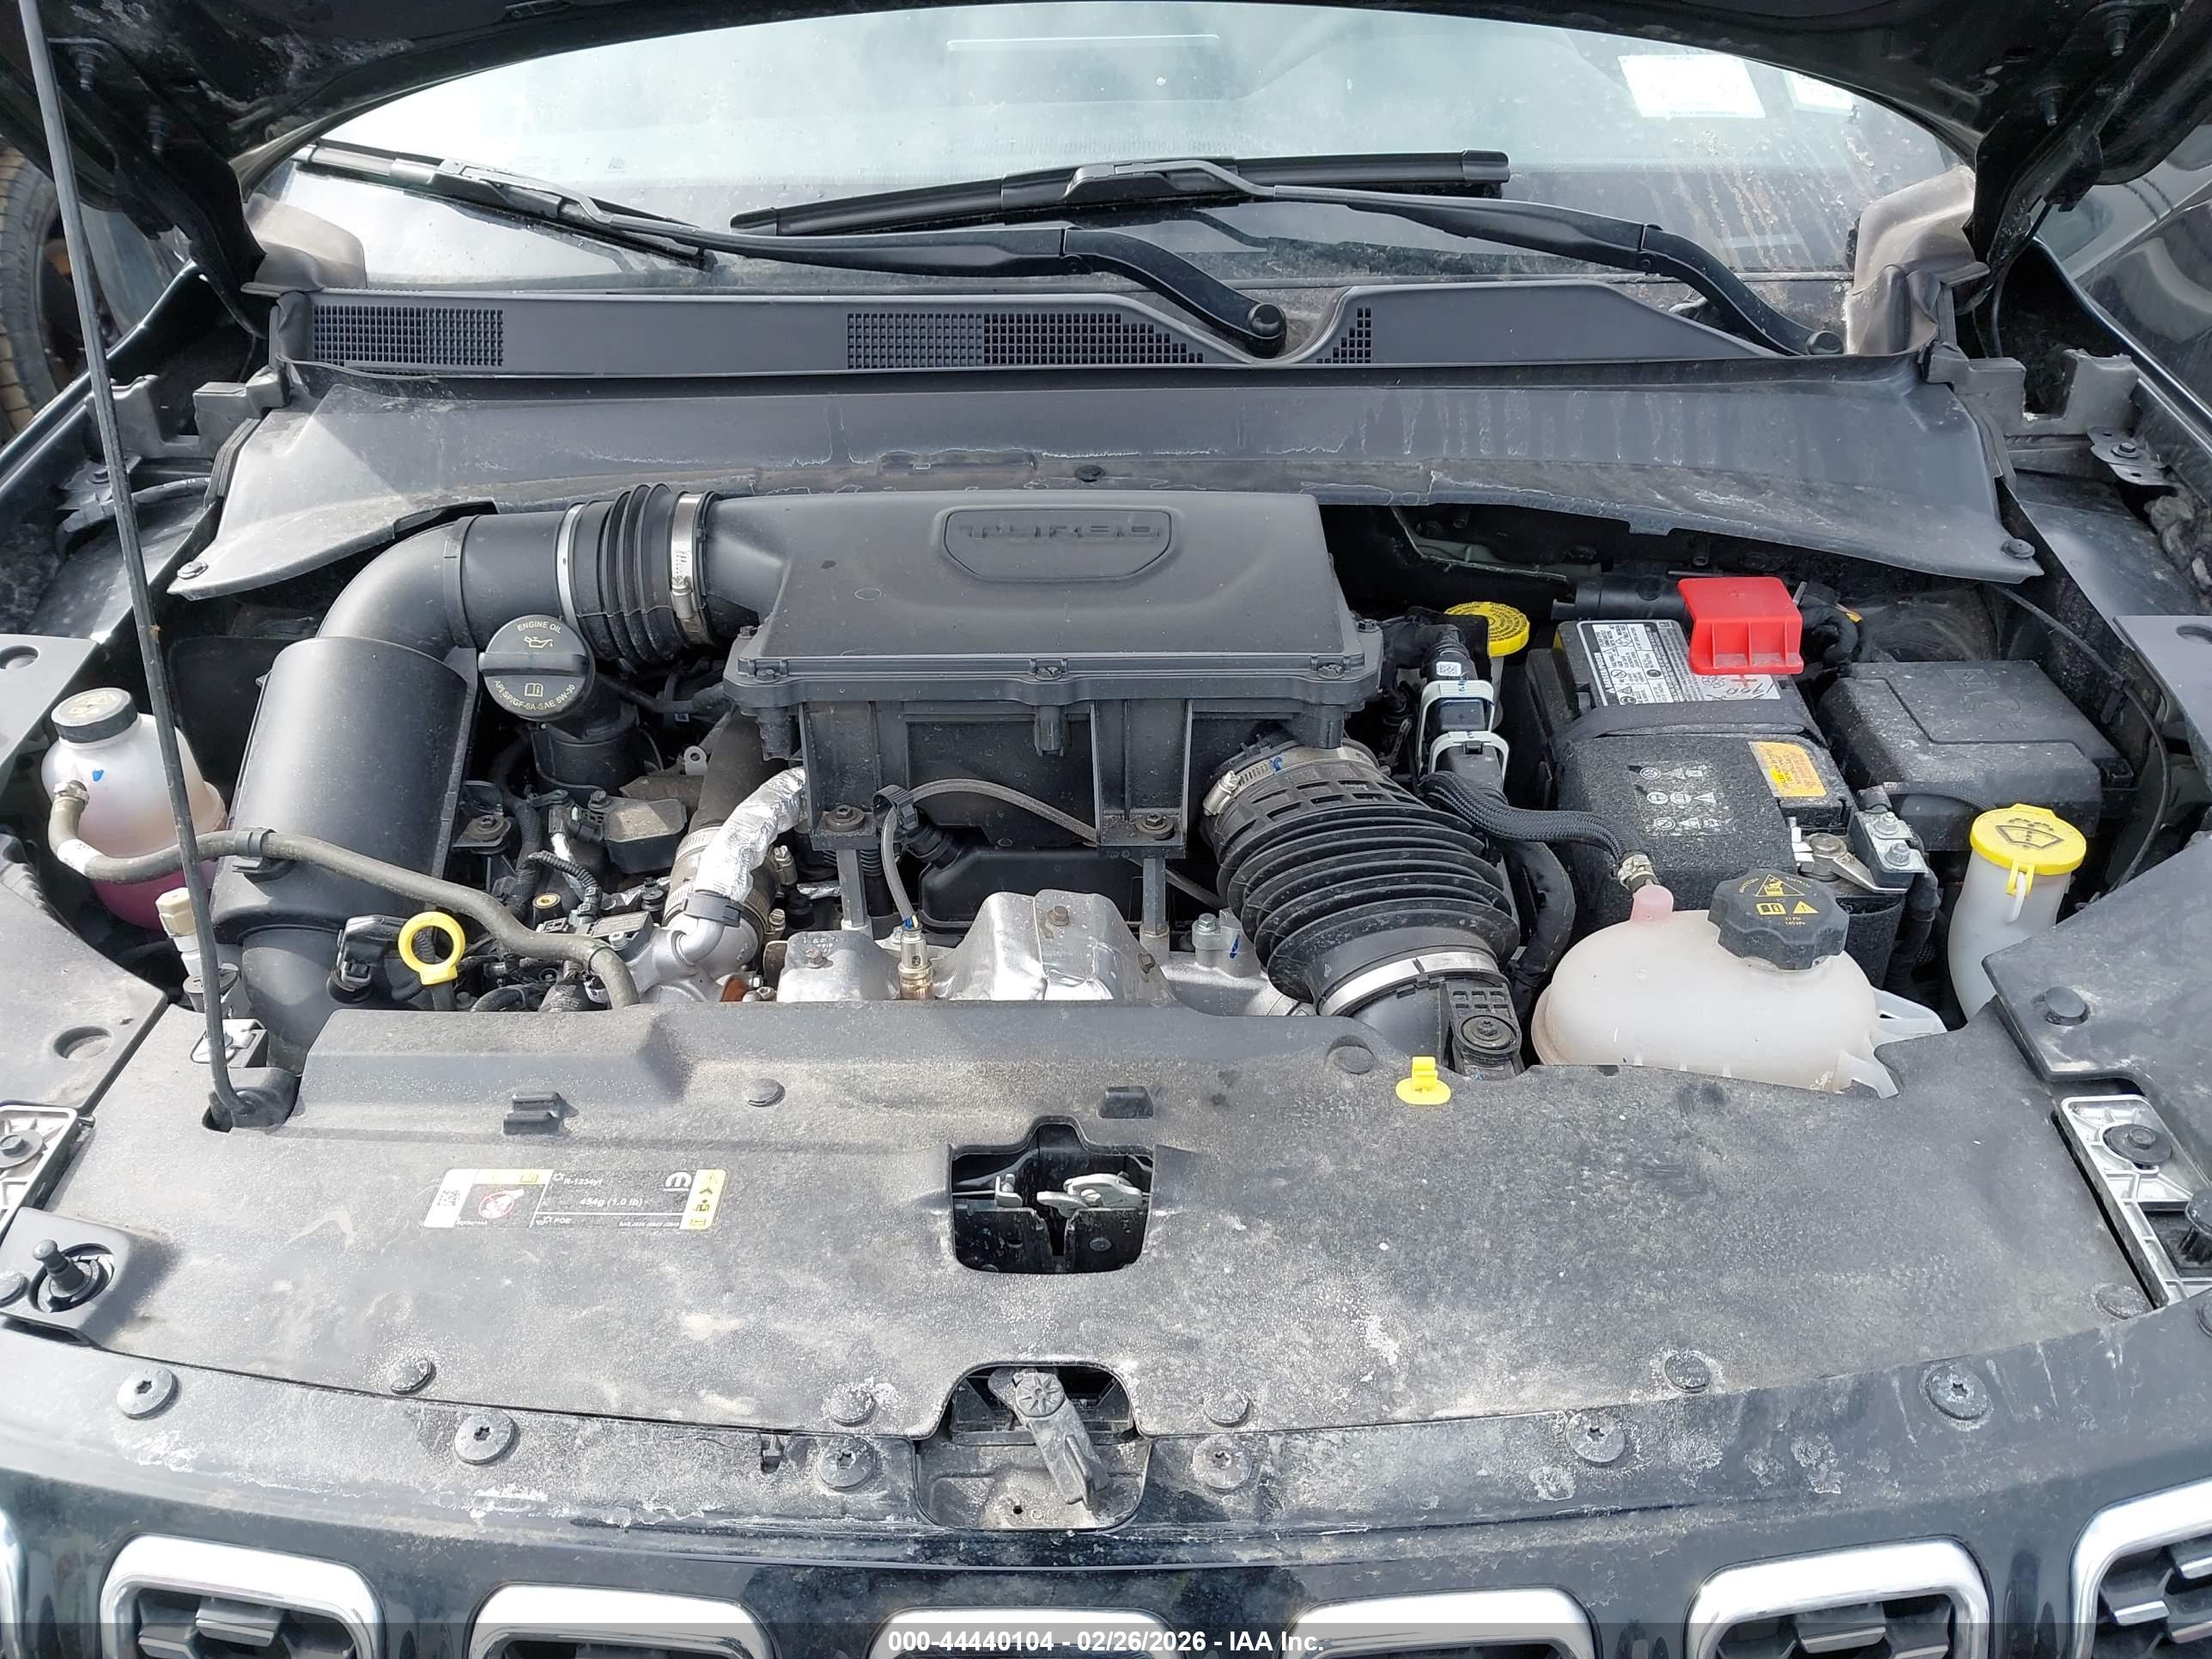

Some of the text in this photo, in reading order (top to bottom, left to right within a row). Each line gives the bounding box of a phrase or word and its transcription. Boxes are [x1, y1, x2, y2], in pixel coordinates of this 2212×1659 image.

[517, 620, 562, 634] ENGINE OIL
[494, 681, 506, 694] API
[556, 684, 576, 704] 5W-30
